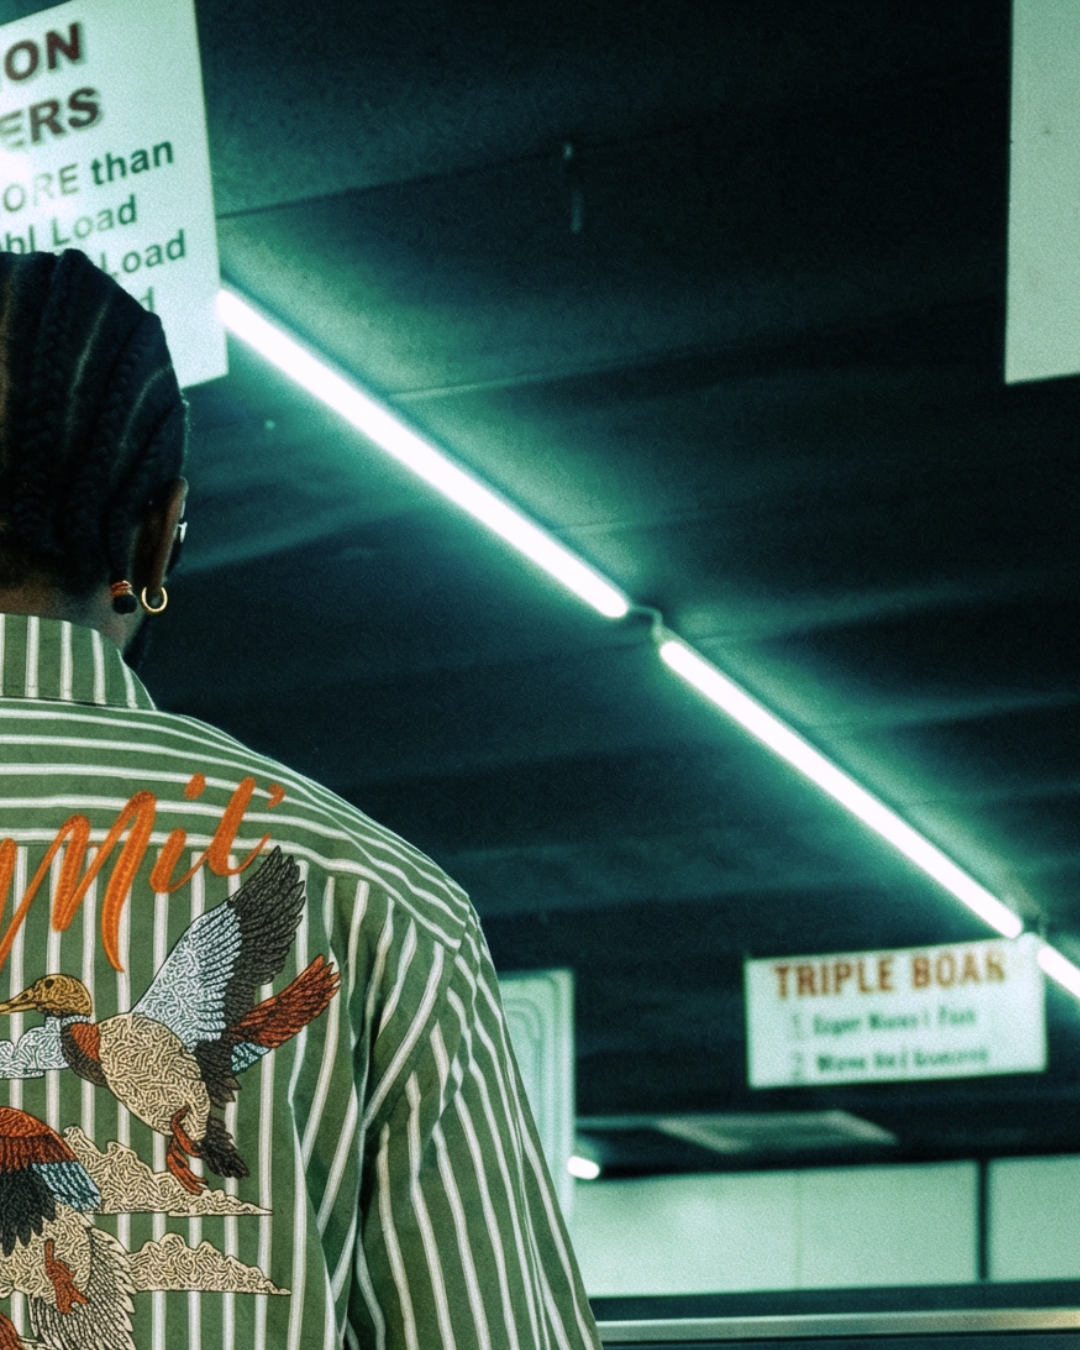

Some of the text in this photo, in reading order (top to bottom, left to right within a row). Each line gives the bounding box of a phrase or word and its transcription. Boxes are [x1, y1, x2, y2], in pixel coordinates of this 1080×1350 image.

[90, 140, 175, 187] than
[51, 193, 137, 247] Load
[774, 955, 895, 999] TRIPLE
